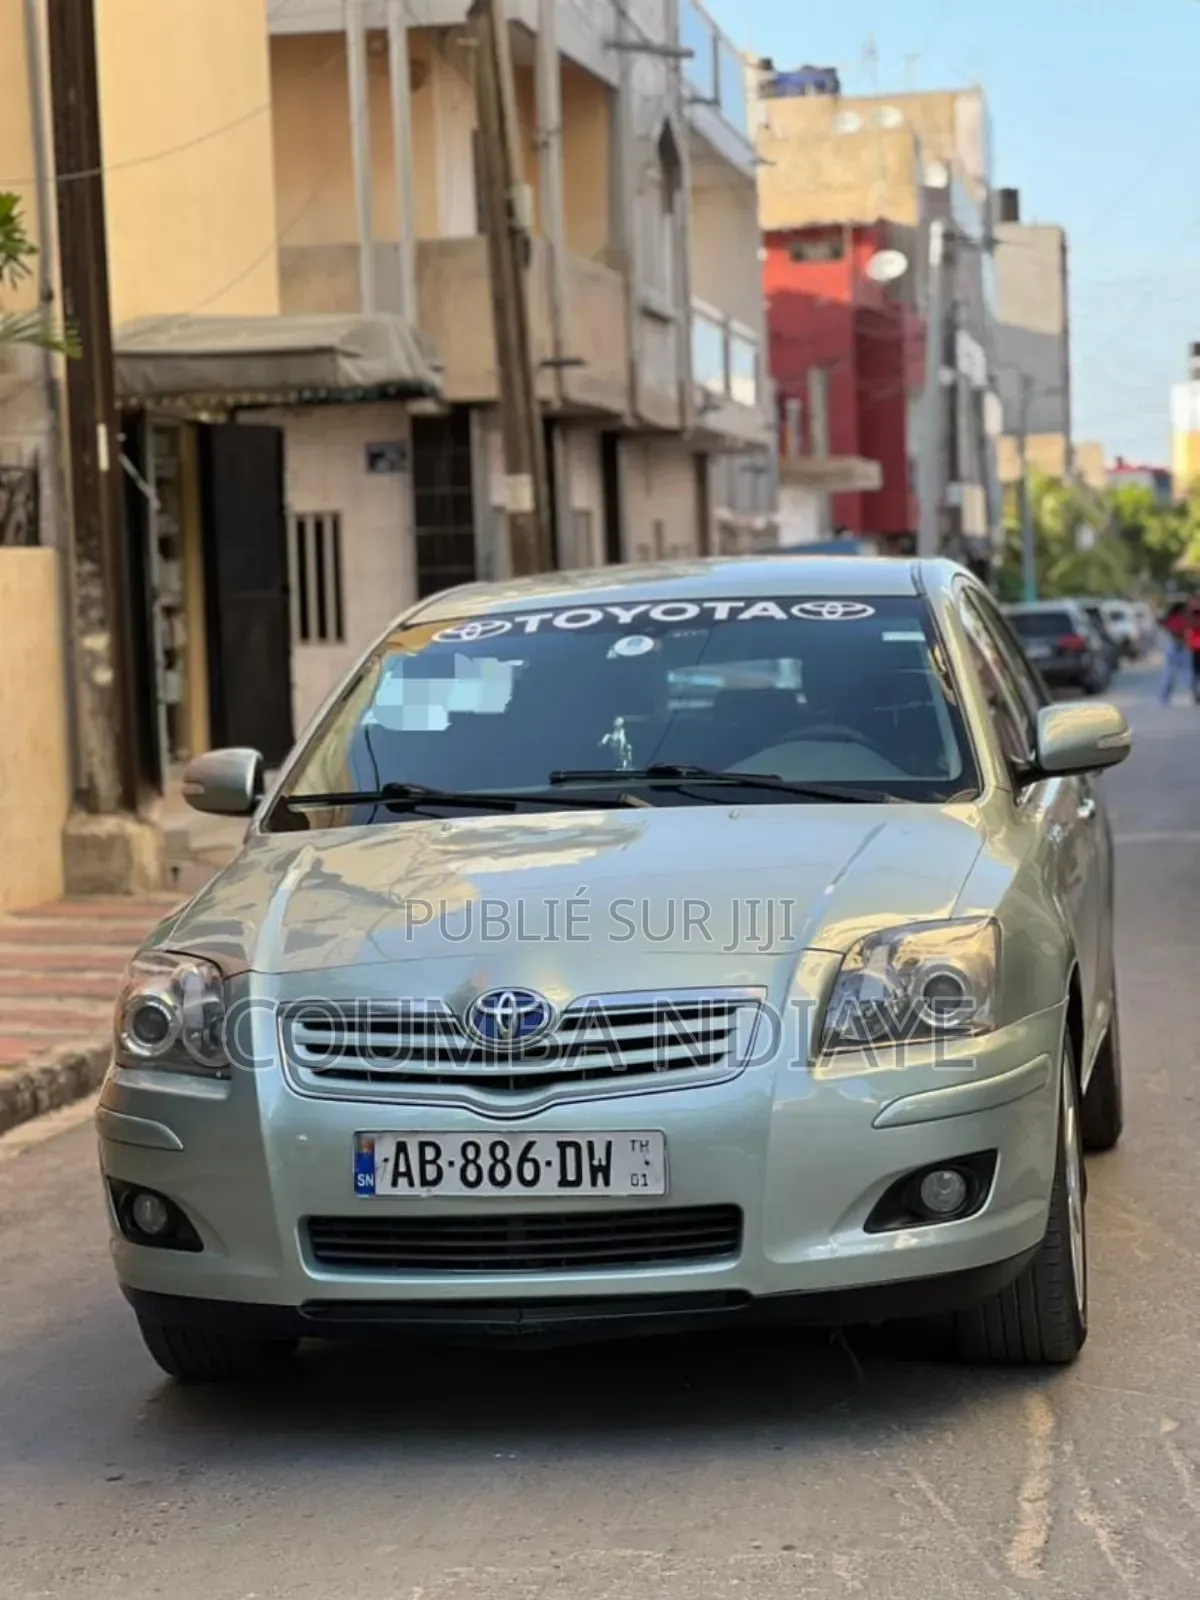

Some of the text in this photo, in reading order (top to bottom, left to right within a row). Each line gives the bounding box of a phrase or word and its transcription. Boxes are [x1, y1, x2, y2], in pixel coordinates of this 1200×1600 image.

[514, 601, 788, 633] TOYOTA
[357, 1173, 375, 1187] SN
[630, 1172, 649, 1187] 01
